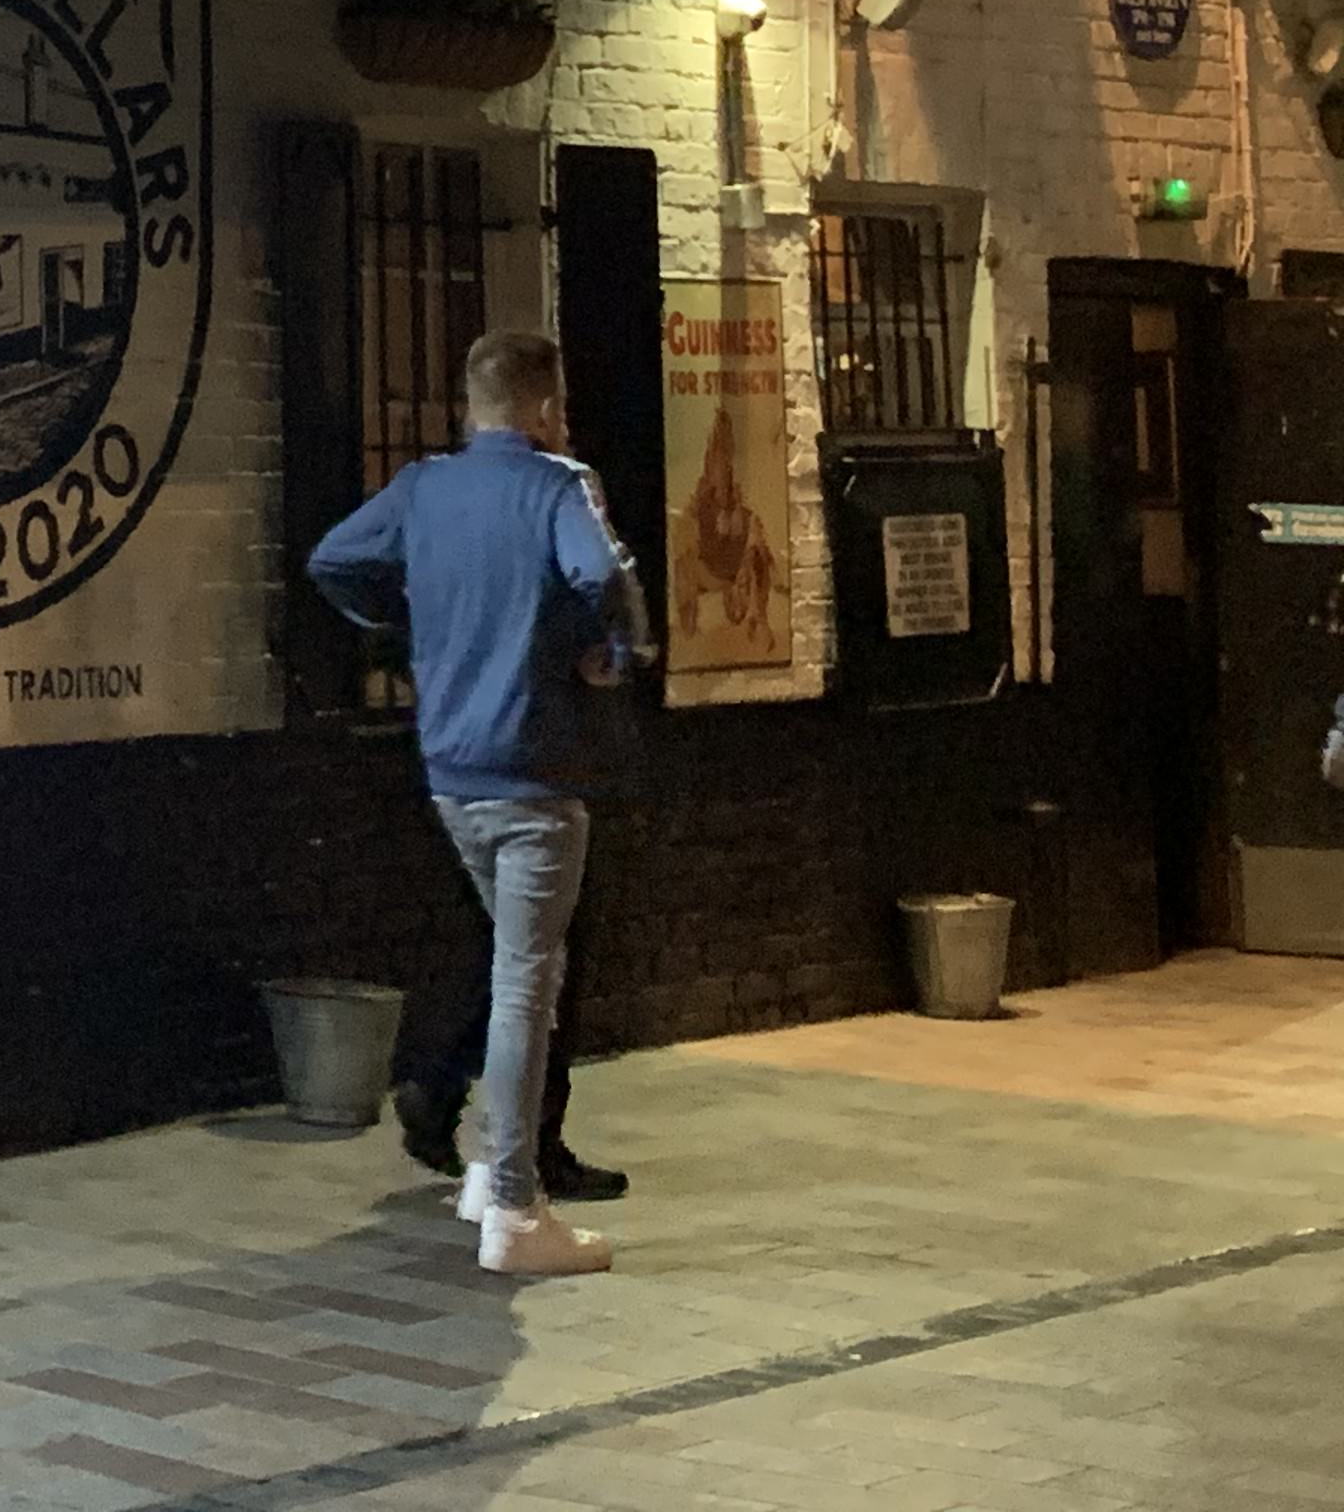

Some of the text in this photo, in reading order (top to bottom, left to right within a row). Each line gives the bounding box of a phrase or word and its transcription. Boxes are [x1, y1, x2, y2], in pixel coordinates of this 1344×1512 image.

[668, 311, 778, 356] GUINNESS
[669, 370, 698, 396] FOR
[3, 662, 144, 703] TRADITION
